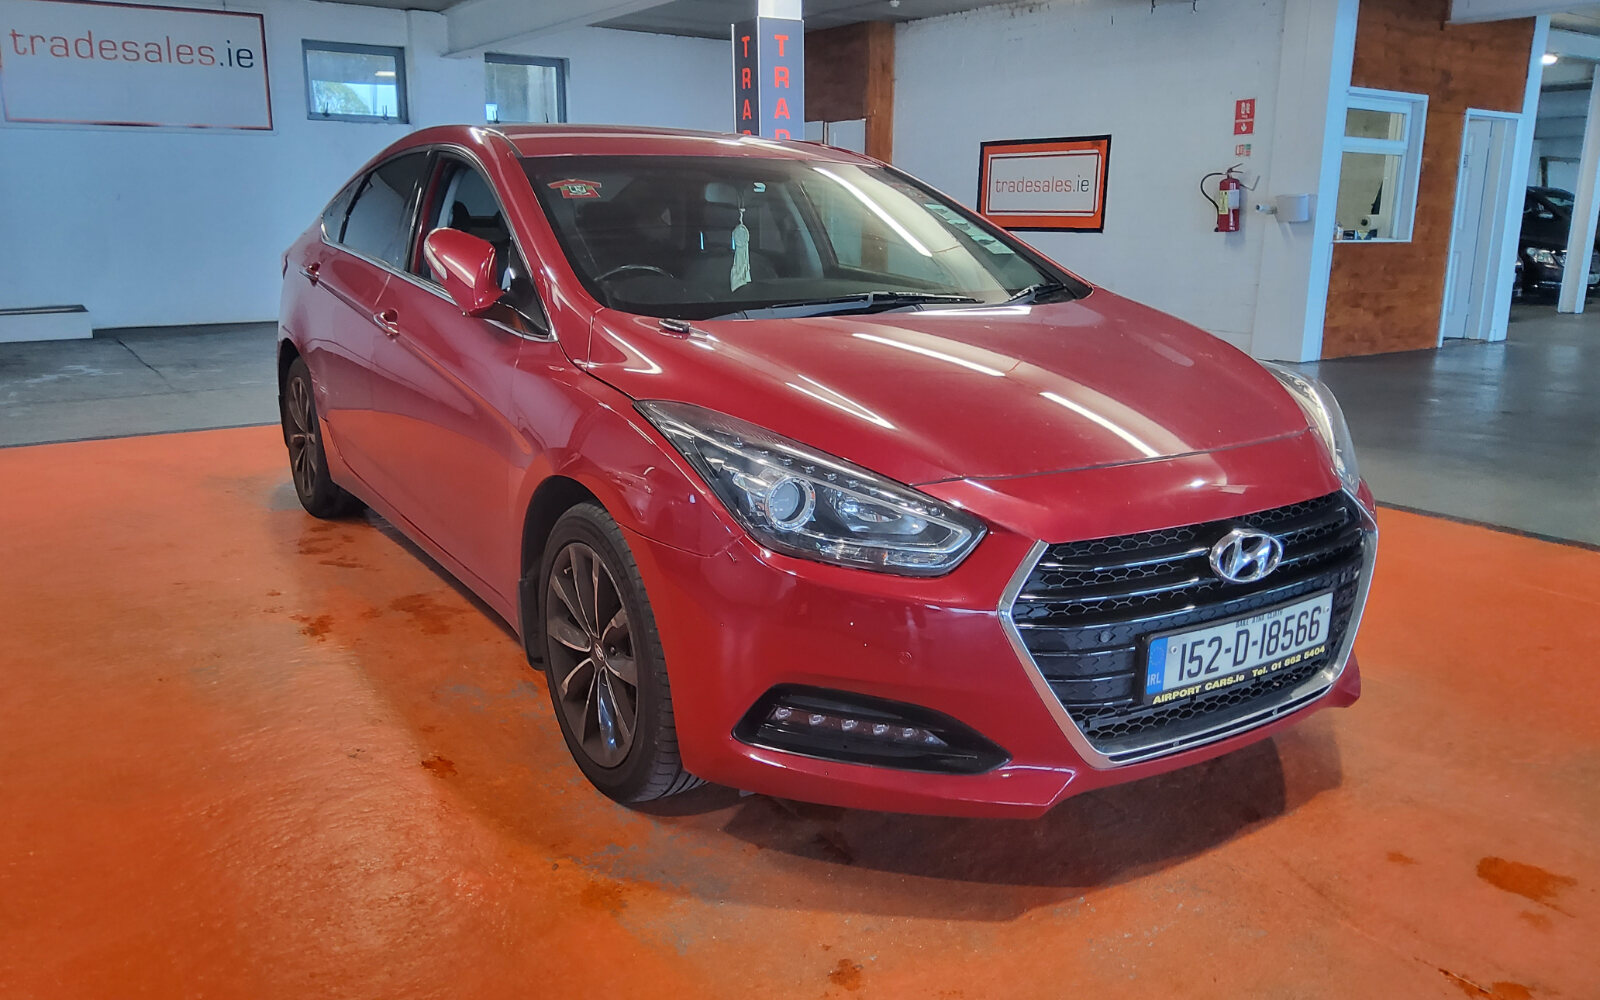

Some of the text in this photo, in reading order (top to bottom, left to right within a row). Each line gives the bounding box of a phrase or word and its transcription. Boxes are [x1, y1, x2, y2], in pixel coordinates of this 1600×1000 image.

[9, 28, 254, 69] tradesales.ie
[741, 35, 752, 136] TRA
[995, 174, 1090, 193] tradesales.ie
[1178, 605, 1322, 681] 152-D-18566
[1147, 672, 1161, 686] IRL
[1152, 684, 1202, 704] AIRPORT
[1252, 666, 1268, 677] Tel.
[1271, 661, 1282, 671] 01
[1304, 645, 1325, 660] 5404
